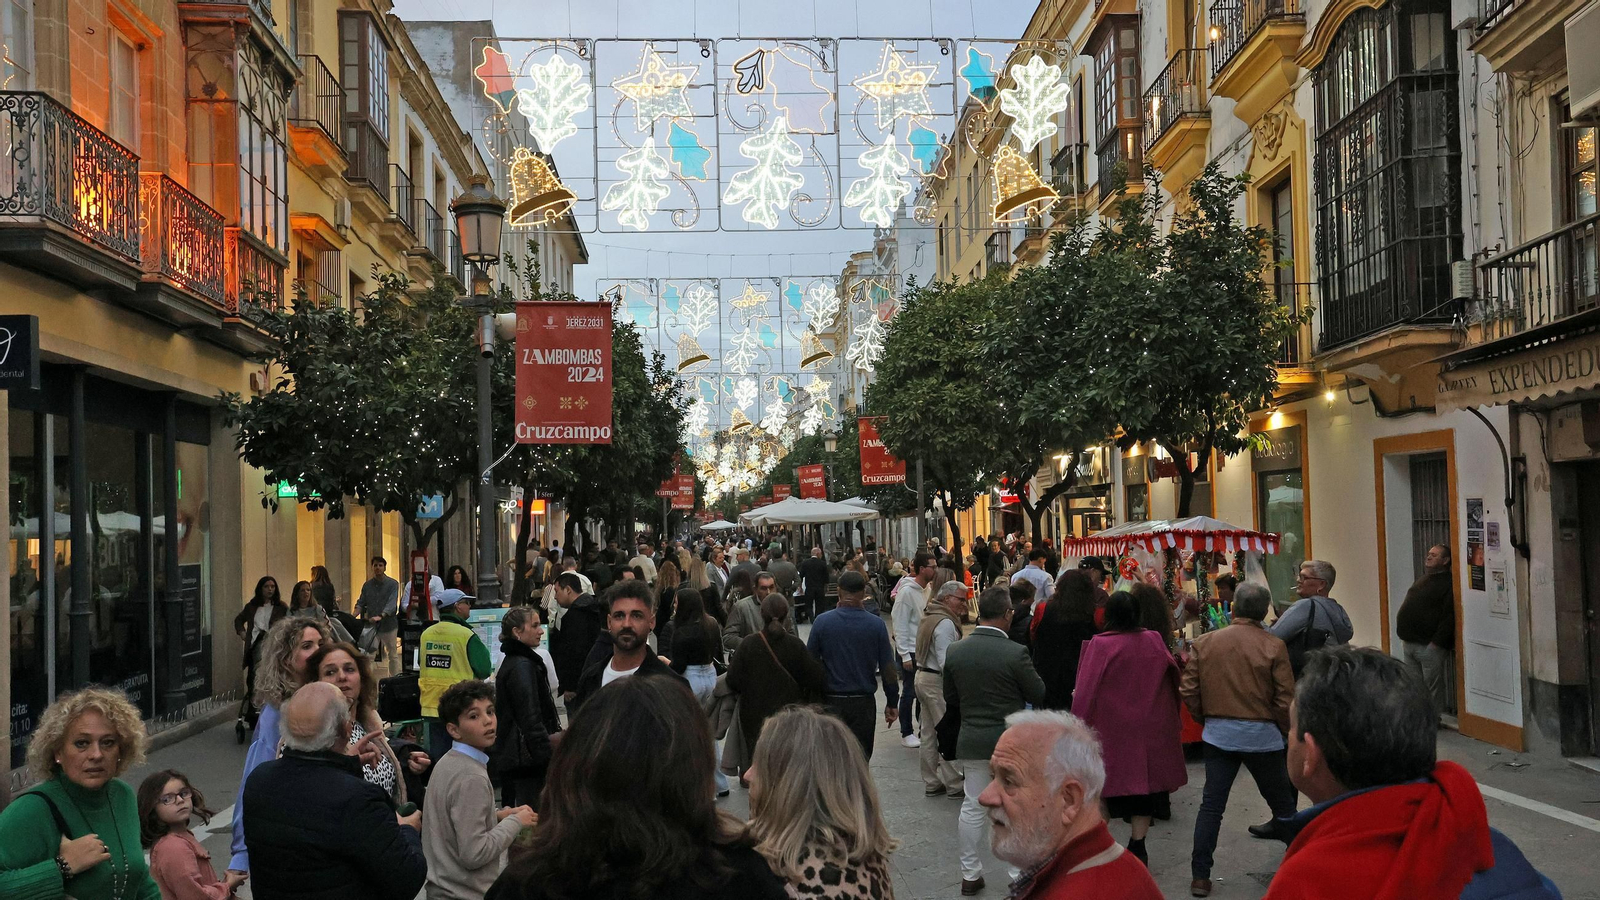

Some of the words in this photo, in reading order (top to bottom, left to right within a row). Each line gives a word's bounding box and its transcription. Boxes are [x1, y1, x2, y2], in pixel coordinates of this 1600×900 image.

[566, 318, 587, 327] JEREZ
[588, 318, 604, 327] 2031
[522, 348, 602, 365] ZAMBOMBAS
[567, 366, 604, 383] 2024
[516, 421, 611, 441] Cruzcampo
[861, 474, 906, 483] Cruzcampo
[11, 703, 28, 717] cita:
[20, 717, 31, 732] 10
